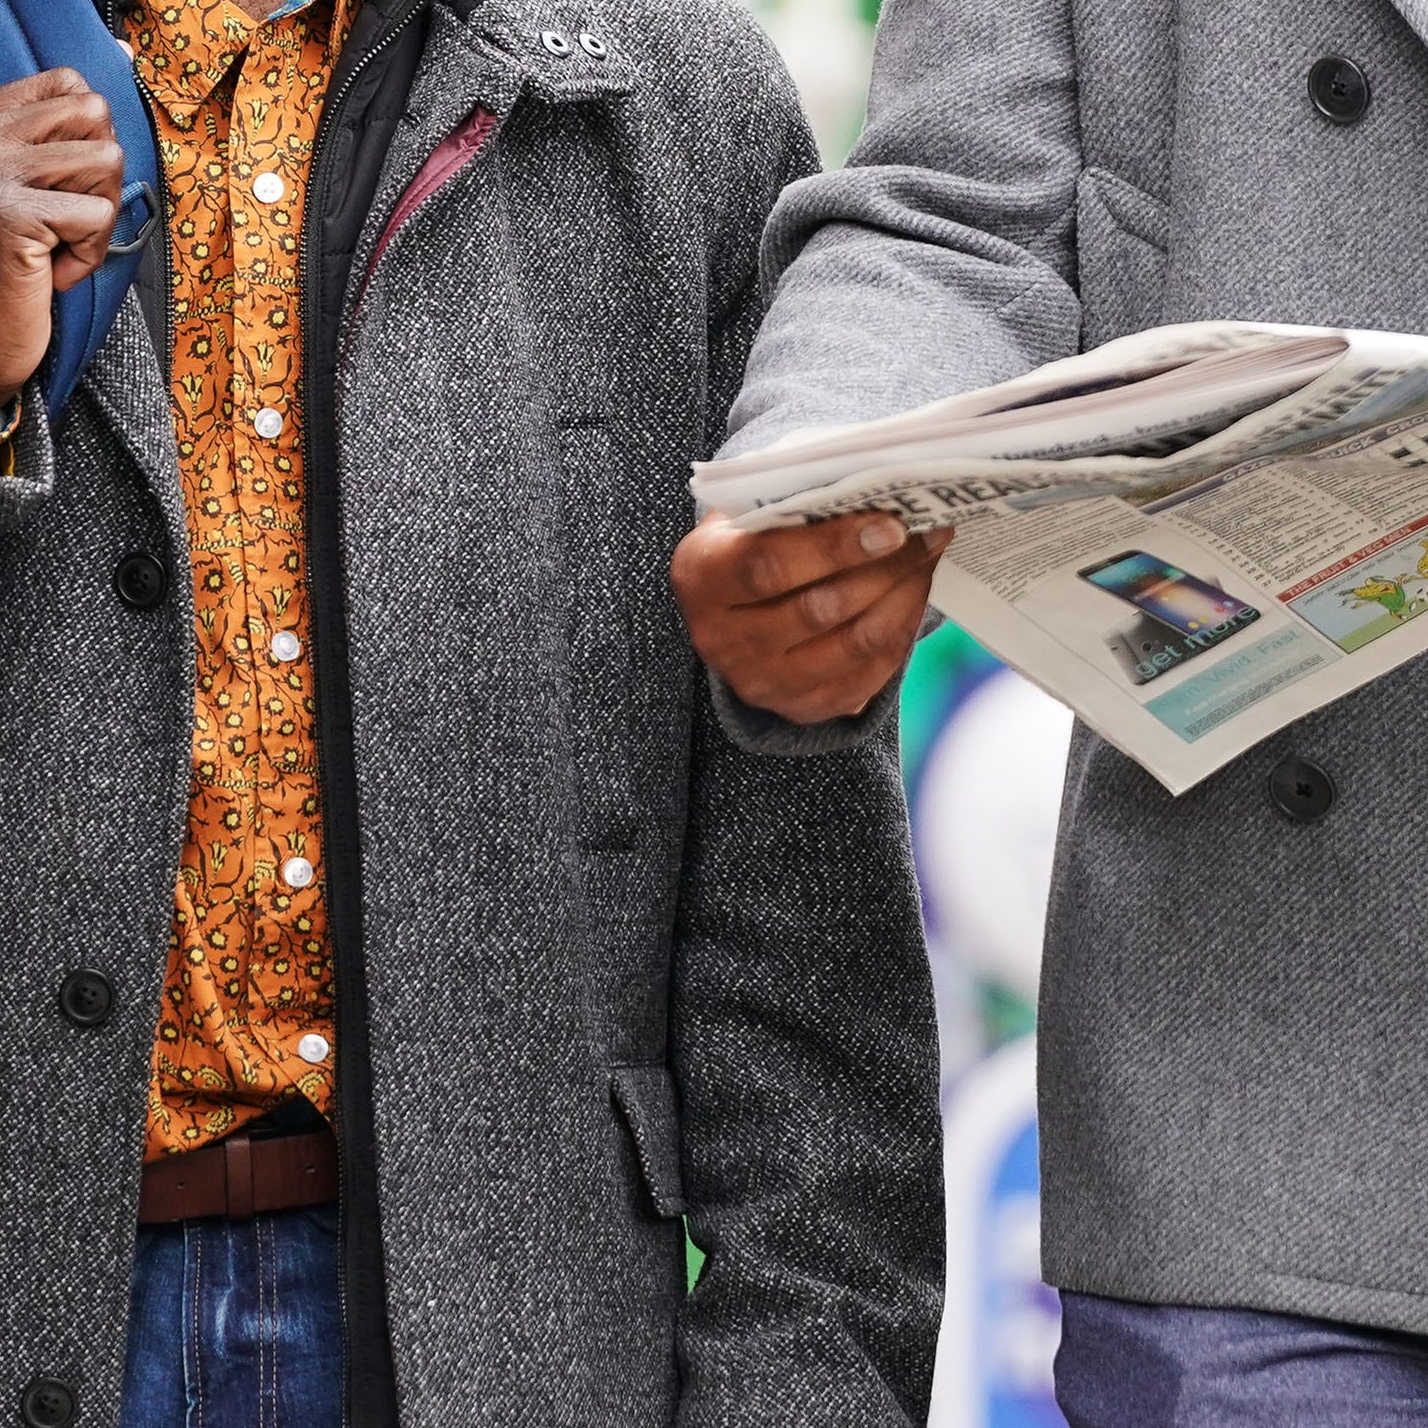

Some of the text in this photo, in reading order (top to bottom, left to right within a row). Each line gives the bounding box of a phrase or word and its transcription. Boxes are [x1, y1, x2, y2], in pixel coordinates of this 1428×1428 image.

[1319, 430, 1375, 460] UICK
[1284, 525, 1413, 598] THE FRUIT & VEG MEN
[1134, 605, 1258, 678] get more
